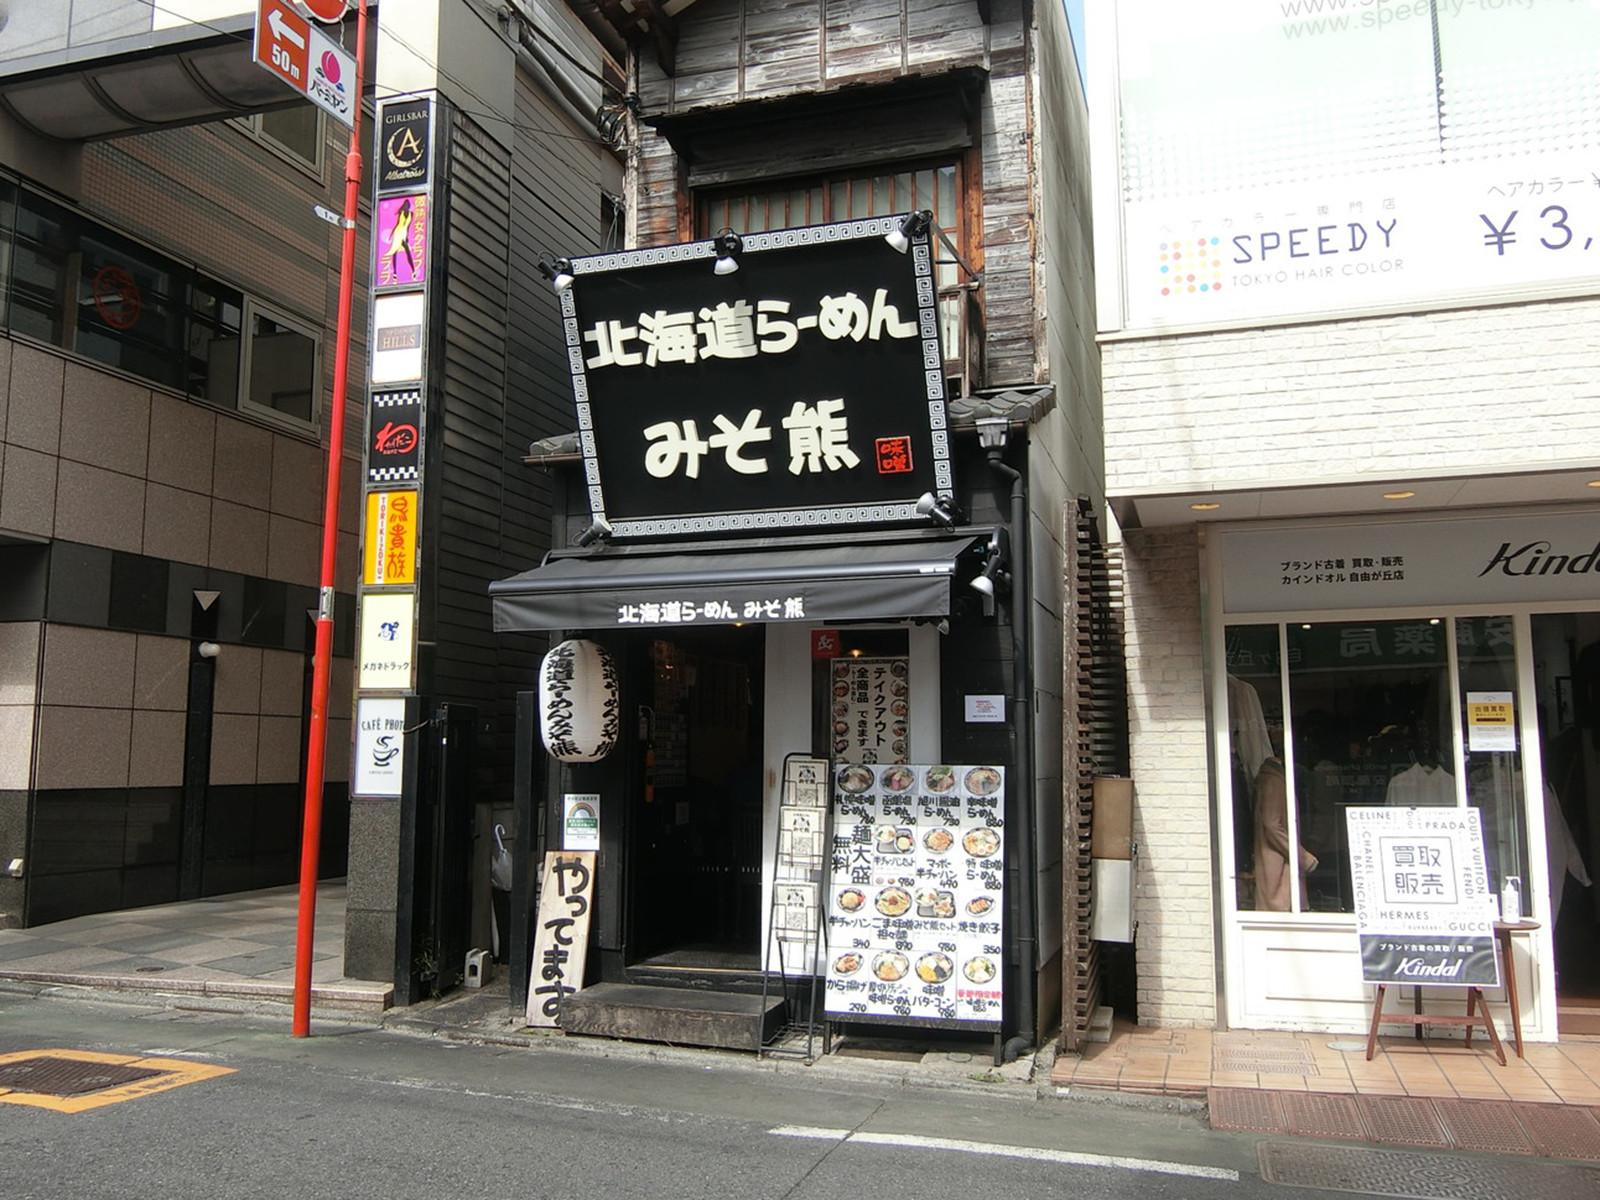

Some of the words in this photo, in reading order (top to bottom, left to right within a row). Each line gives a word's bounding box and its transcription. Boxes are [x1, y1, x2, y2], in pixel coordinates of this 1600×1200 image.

[310, 79, 348, 114] バーミヤン
[385, 110, 428, 124] GIRLSBAR
[1487, 177, 1585, 198] ヘアカラー
[1160, 198, 1397, 232] ヘアカラー専門店
[1232, 218, 1398, 265] SPEEDY
[1232, 270, 1288, 288] TOKYO
[1295, 266, 1335, 280] HAIR
[1342, 258, 1404, 277] COLOR
[584, 288, 919, 370] 北海道らーめん
[383, 335, 416, 350] HILLS
[643, 398, 861, 480] みそ熊
[387, 496, 408, 578] 鳥貴族
[1280, 558, 1345, 572] ブランド古着
[1352, 556, 1404, 569] 買取・販売
[1281, 573, 1346, 585] カインドオル
[1349, 570, 1404, 583] 自由が丘店
[618, 600, 739, 624] 北海道らーめん
[743, 597, 805, 619] みそ熊
[363, 661, 410, 672] メガネトラック
[857, 666, 869, 703] 全商品
[547, 641, 583, 757] 北海道らーめんみそ熊
[874, 667, 887, 747] テイクアウト
[361, 715, 381, 731] CAFÉ
[857, 710, 869, 747] できます
[841, 804, 869, 818] らーめん
[883, 806, 910, 817] らーめん
[924, 806, 953, 819] らーめん
[967, 807, 997, 820] らーめん
[1349, 811, 1392, 820] CELINE
[1425, 822, 1466, 830] PRADA
[1467, 810, 1480, 842] LOUIS
[832, 834, 852, 874] 無料
[851, 825, 873, 884] 麺大盛
[1362, 830, 1374, 874] CHANEL
[1392, 845, 1441, 868] 買取
[916, 868, 958, 879] 半チャーハン
[966, 870, 999, 882] らーめん
[1472, 847, 1485, 894] VUITTON
[1353, 855, 1368, 929] BALENCIAGA
[1394, 872, 1444, 895] 販売
[1462, 867, 1475, 899] FENDI
[828, 915, 871, 928] 半チャーハン
[914, 920, 957, 931] みそ熊セット
[1380, 911, 1430, 920] HERMES
[958, 921, 1001, 934] 焼き餃子
[1448, 922, 1492, 932] GUCCI
[534, 856, 590, 1025] やってます
[1394, 957, 1464, 977] Kindal
[912, 996, 955, 1009] バターコーン
